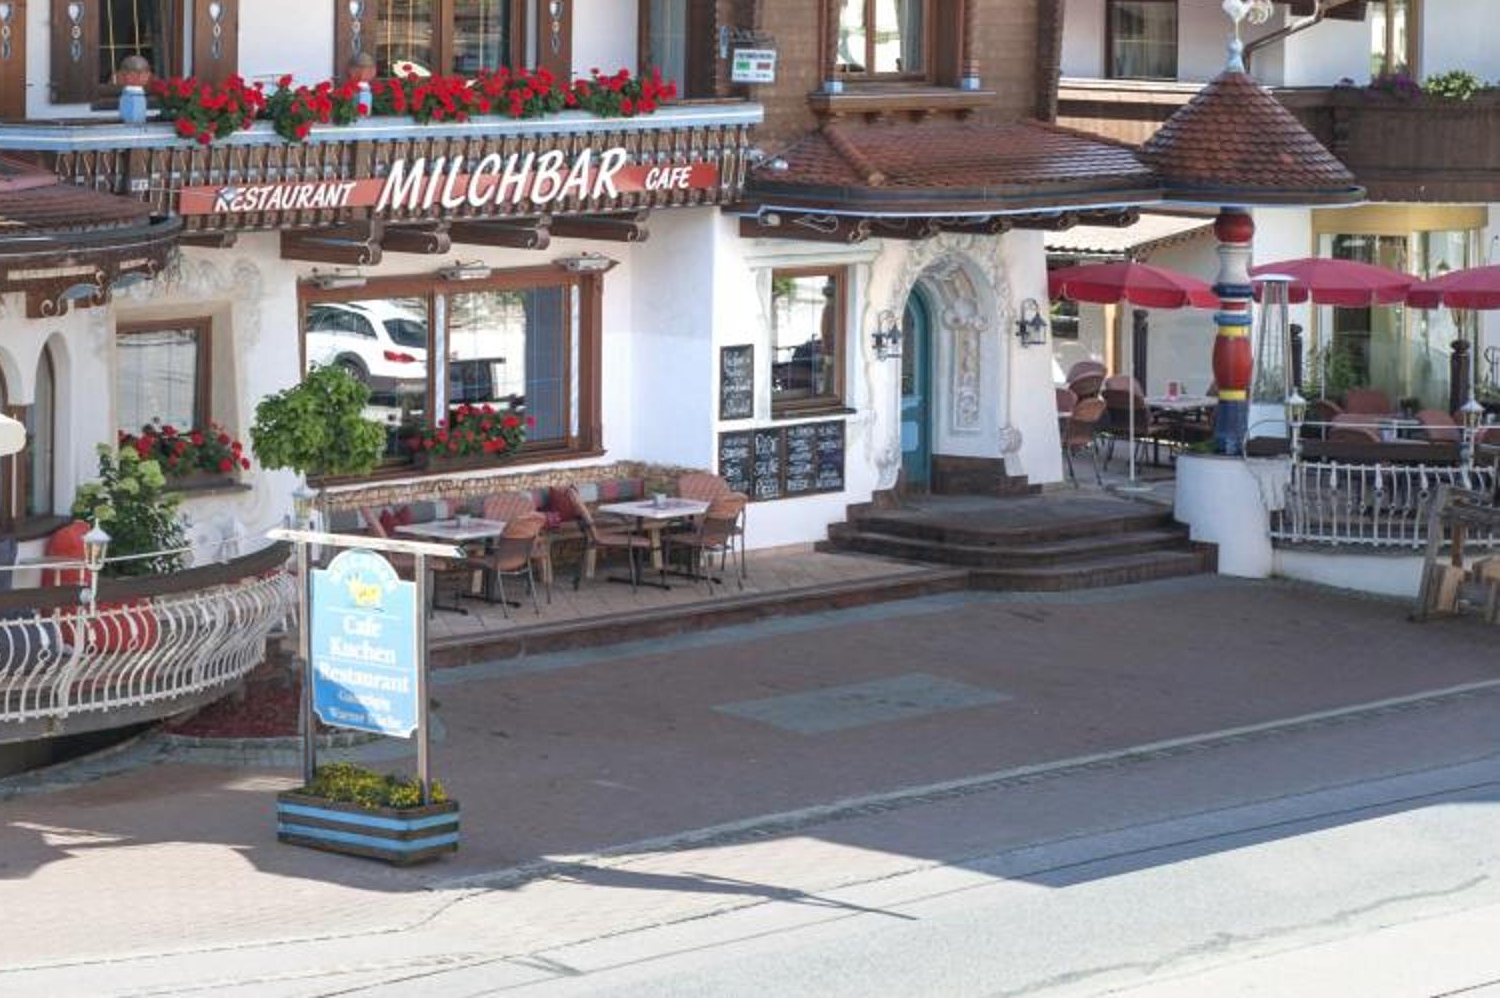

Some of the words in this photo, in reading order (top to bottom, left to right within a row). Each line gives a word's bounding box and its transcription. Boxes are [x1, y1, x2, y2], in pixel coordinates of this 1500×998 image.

[376, 147, 627, 212] MILCHBAR
[645, 165, 693, 190] CAFE
[318, 661, 409, 694] Restaurant
